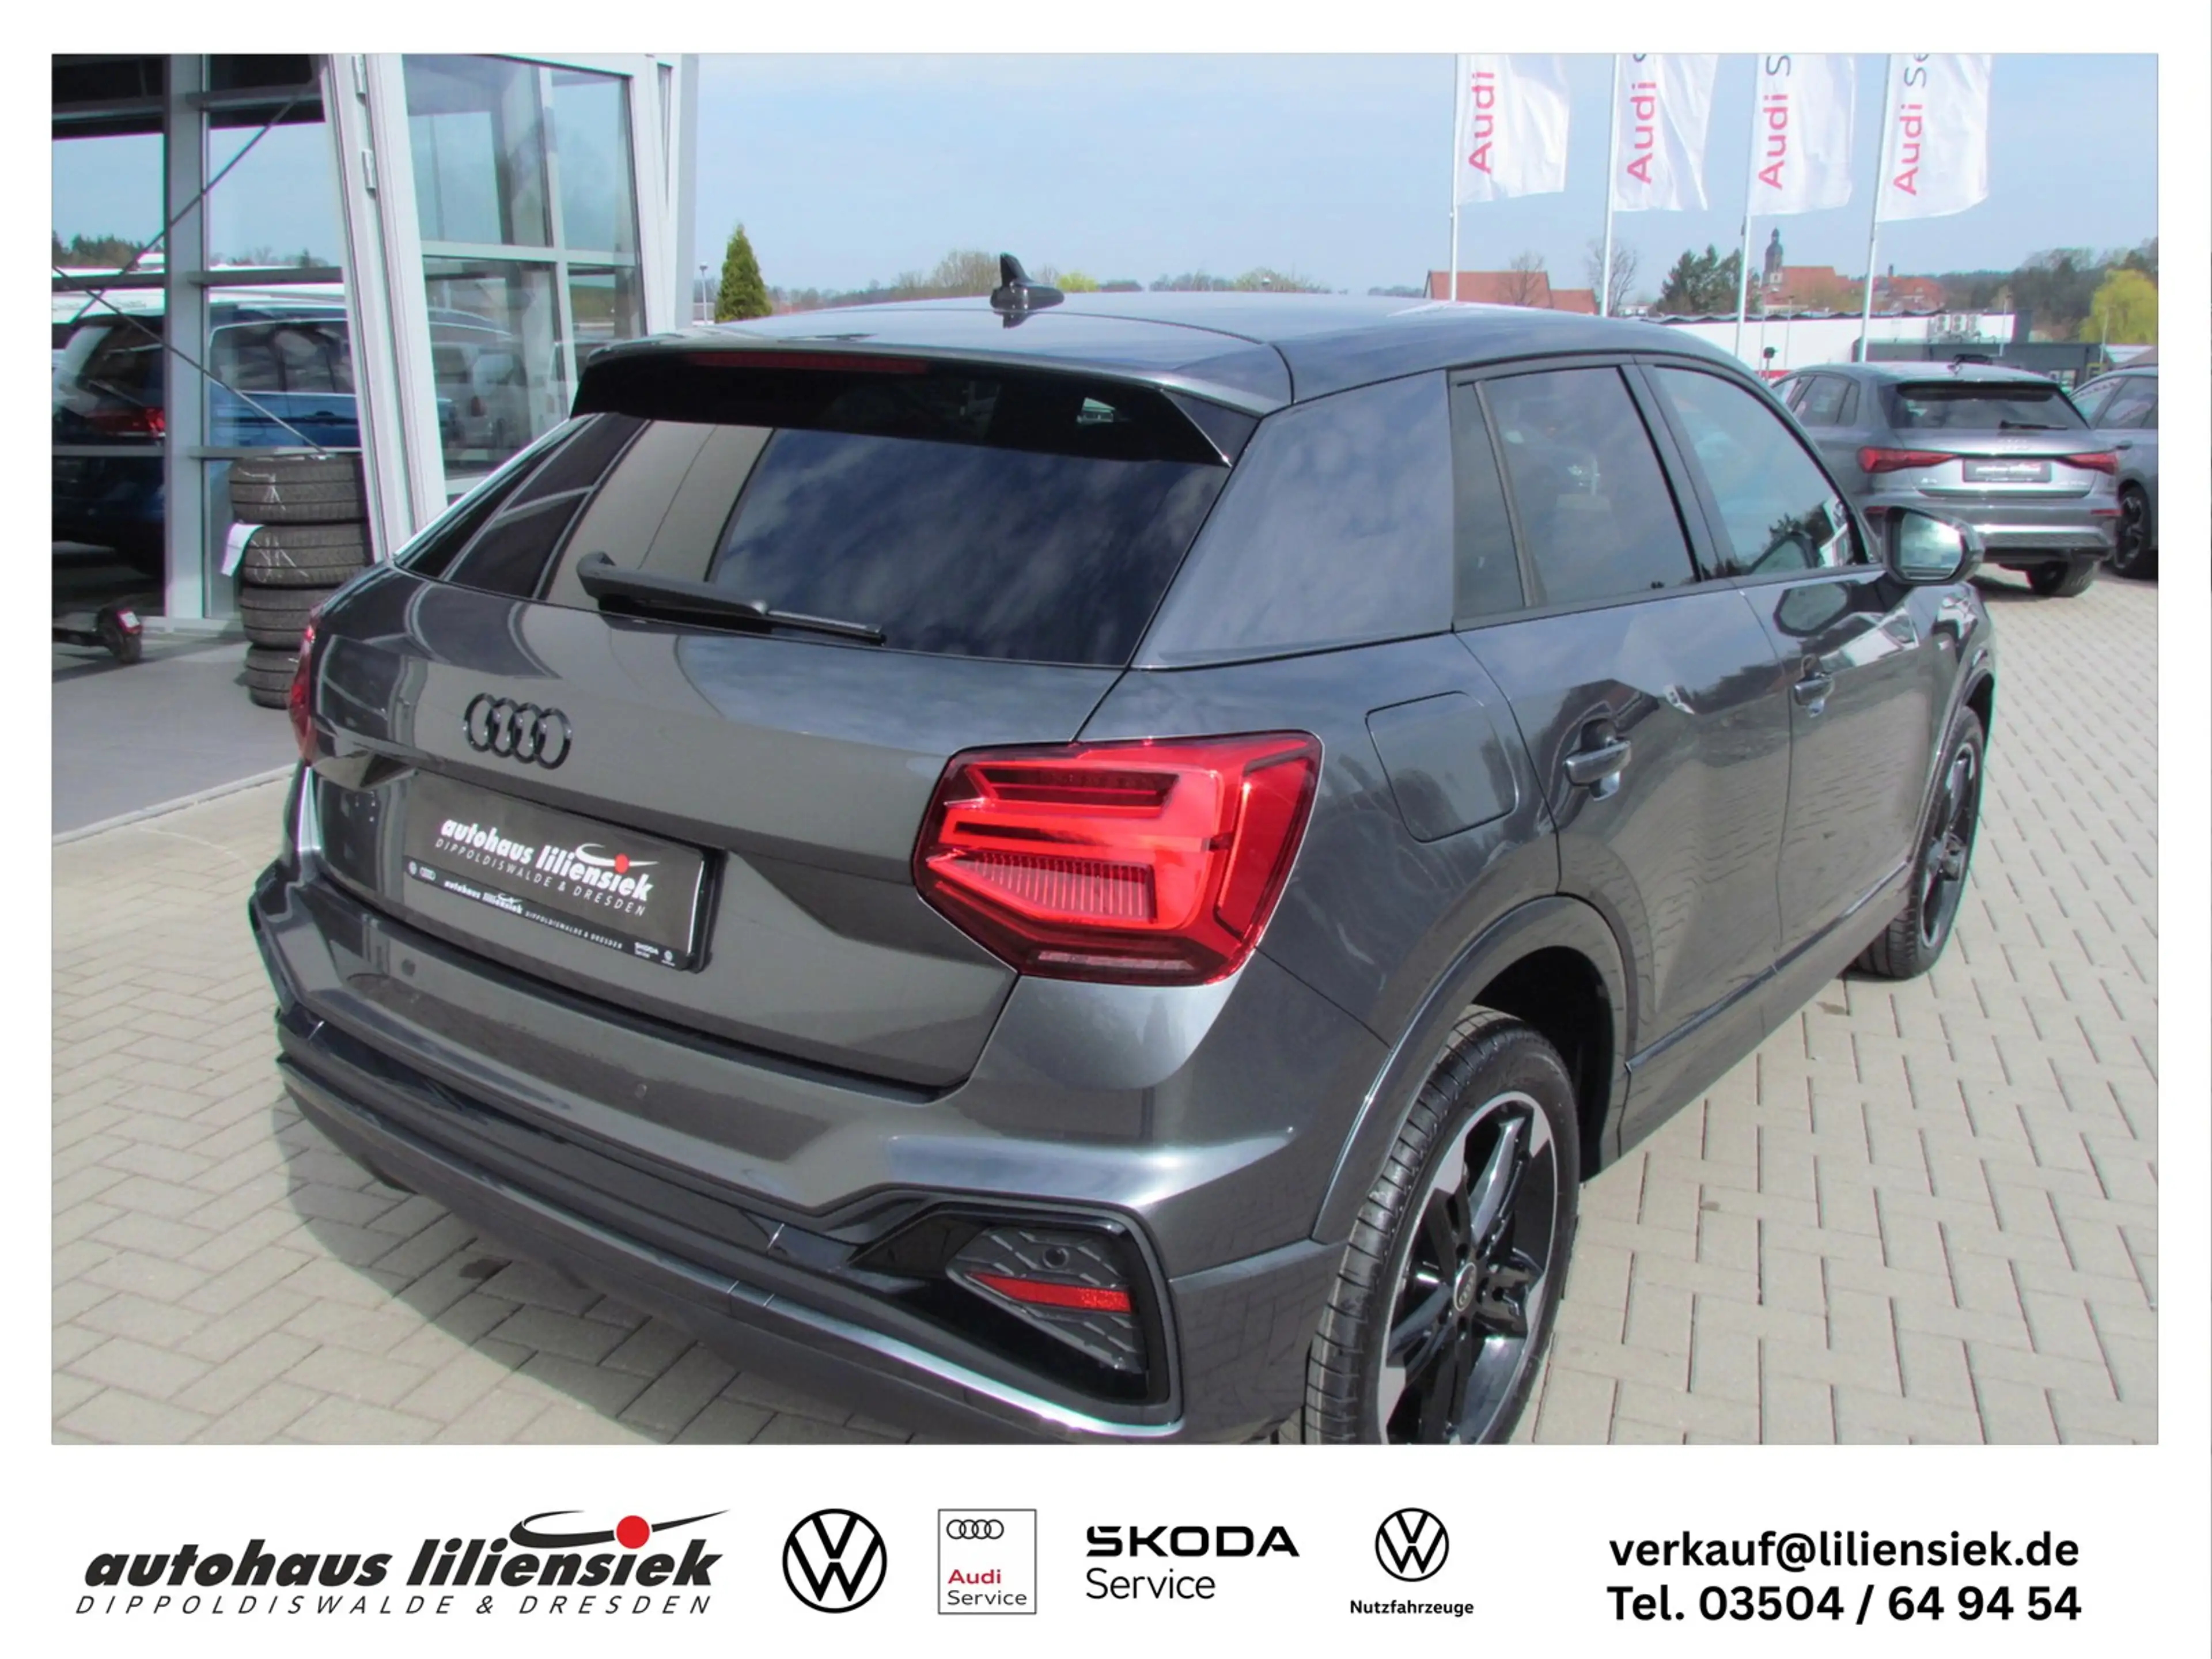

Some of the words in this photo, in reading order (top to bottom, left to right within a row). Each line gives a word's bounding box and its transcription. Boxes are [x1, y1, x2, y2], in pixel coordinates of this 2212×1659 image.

[1468, 71, 1495, 174] Audi
[1627, 82, 1657, 184] Audi
[1758, 94, 1788, 190] Audi
[1893, 104, 1922, 196] Audi
[435, 838, 553, 888] DIPPOLDISWALDE
[558, 880, 567, 892] &
[573, 885, 646, 917] DRESDEN
[441, 819, 535, 864] autohaus
[535, 844, 654, 902] liliensiek
